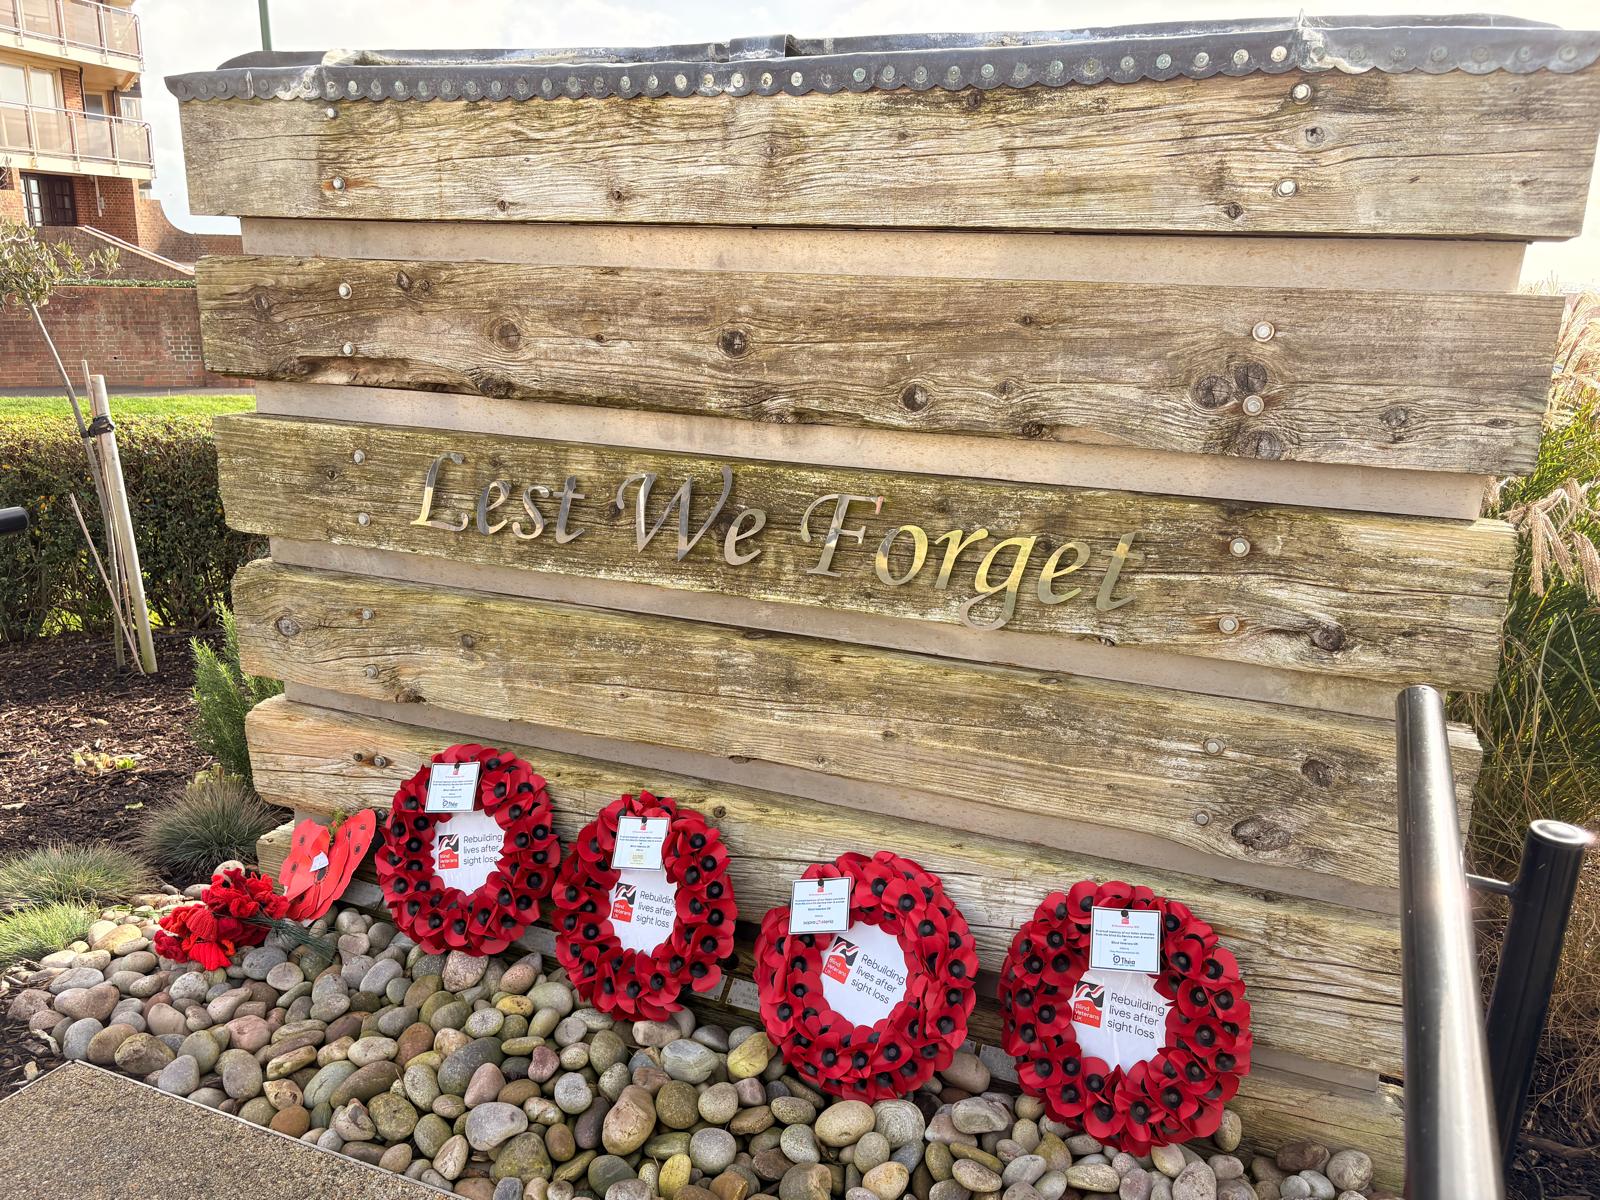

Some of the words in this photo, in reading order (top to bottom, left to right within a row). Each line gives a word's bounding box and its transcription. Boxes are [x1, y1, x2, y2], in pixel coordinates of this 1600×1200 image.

[410, 452, 586, 545] Lest
[617, 464, 768, 566] We
[800, 493, 1146, 631] Forget
[463, 833, 503, 843] Rebuilding
[463, 846, 480, 854] lives
[481, 844, 499, 853] after
[463, 856, 482, 867] sight
[482, 855, 498, 863] loss
[640, 890, 675, 907] Rebuildin
[637, 901, 654, 913] lives
[655, 906, 674, 917] after
[636, 913, 654, 925] sight
[654, 917, 670, 928] loss
[861, 953, 906, 986] Rebuilding
[855, 965, 875, 982] lives
[875, 978, 897, 993] after
[850, 978, 873, 996] sight
[872, 988, 890, 1004] loss
[1075, 1003, 1090, 1012] Blind
[1110, 992, 1165, 1017] Rebuilding
[1074, 1009, 1100, 1021] Veterans
[1109, 1004, 1131, 1020] lives
[1133, 1013, 1160, 1026] after
[1107, 1020, 1133, 1033] sight
[1134, 1025, 1155, 1039] loss
